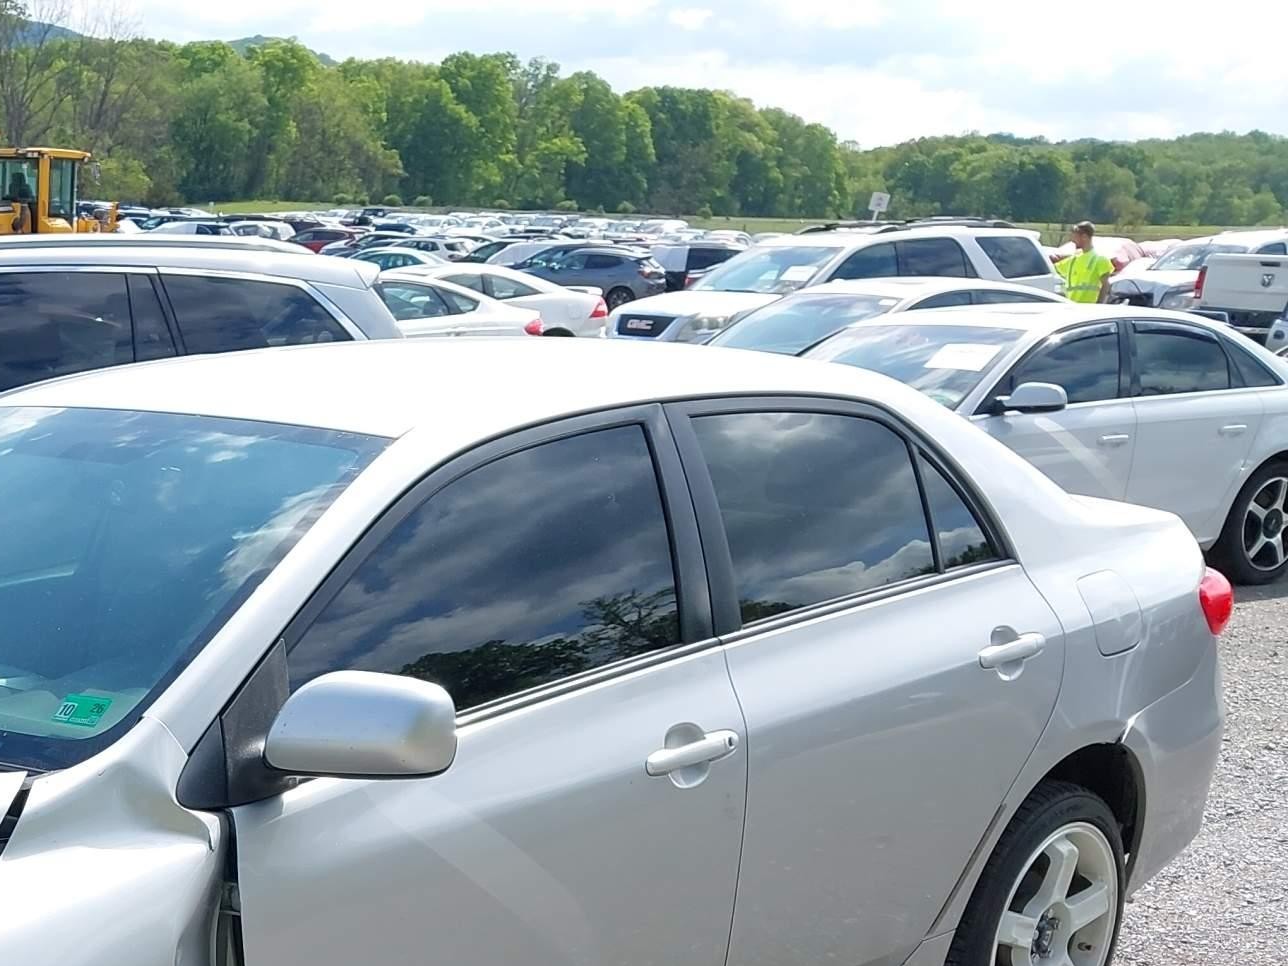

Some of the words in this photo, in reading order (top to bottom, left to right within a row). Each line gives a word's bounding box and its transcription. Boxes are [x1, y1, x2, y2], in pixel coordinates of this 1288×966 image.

[627, 318, 654, 330] GMC
[58, 703, 76, 716] 10
[90, 703, 106, 714] 26
